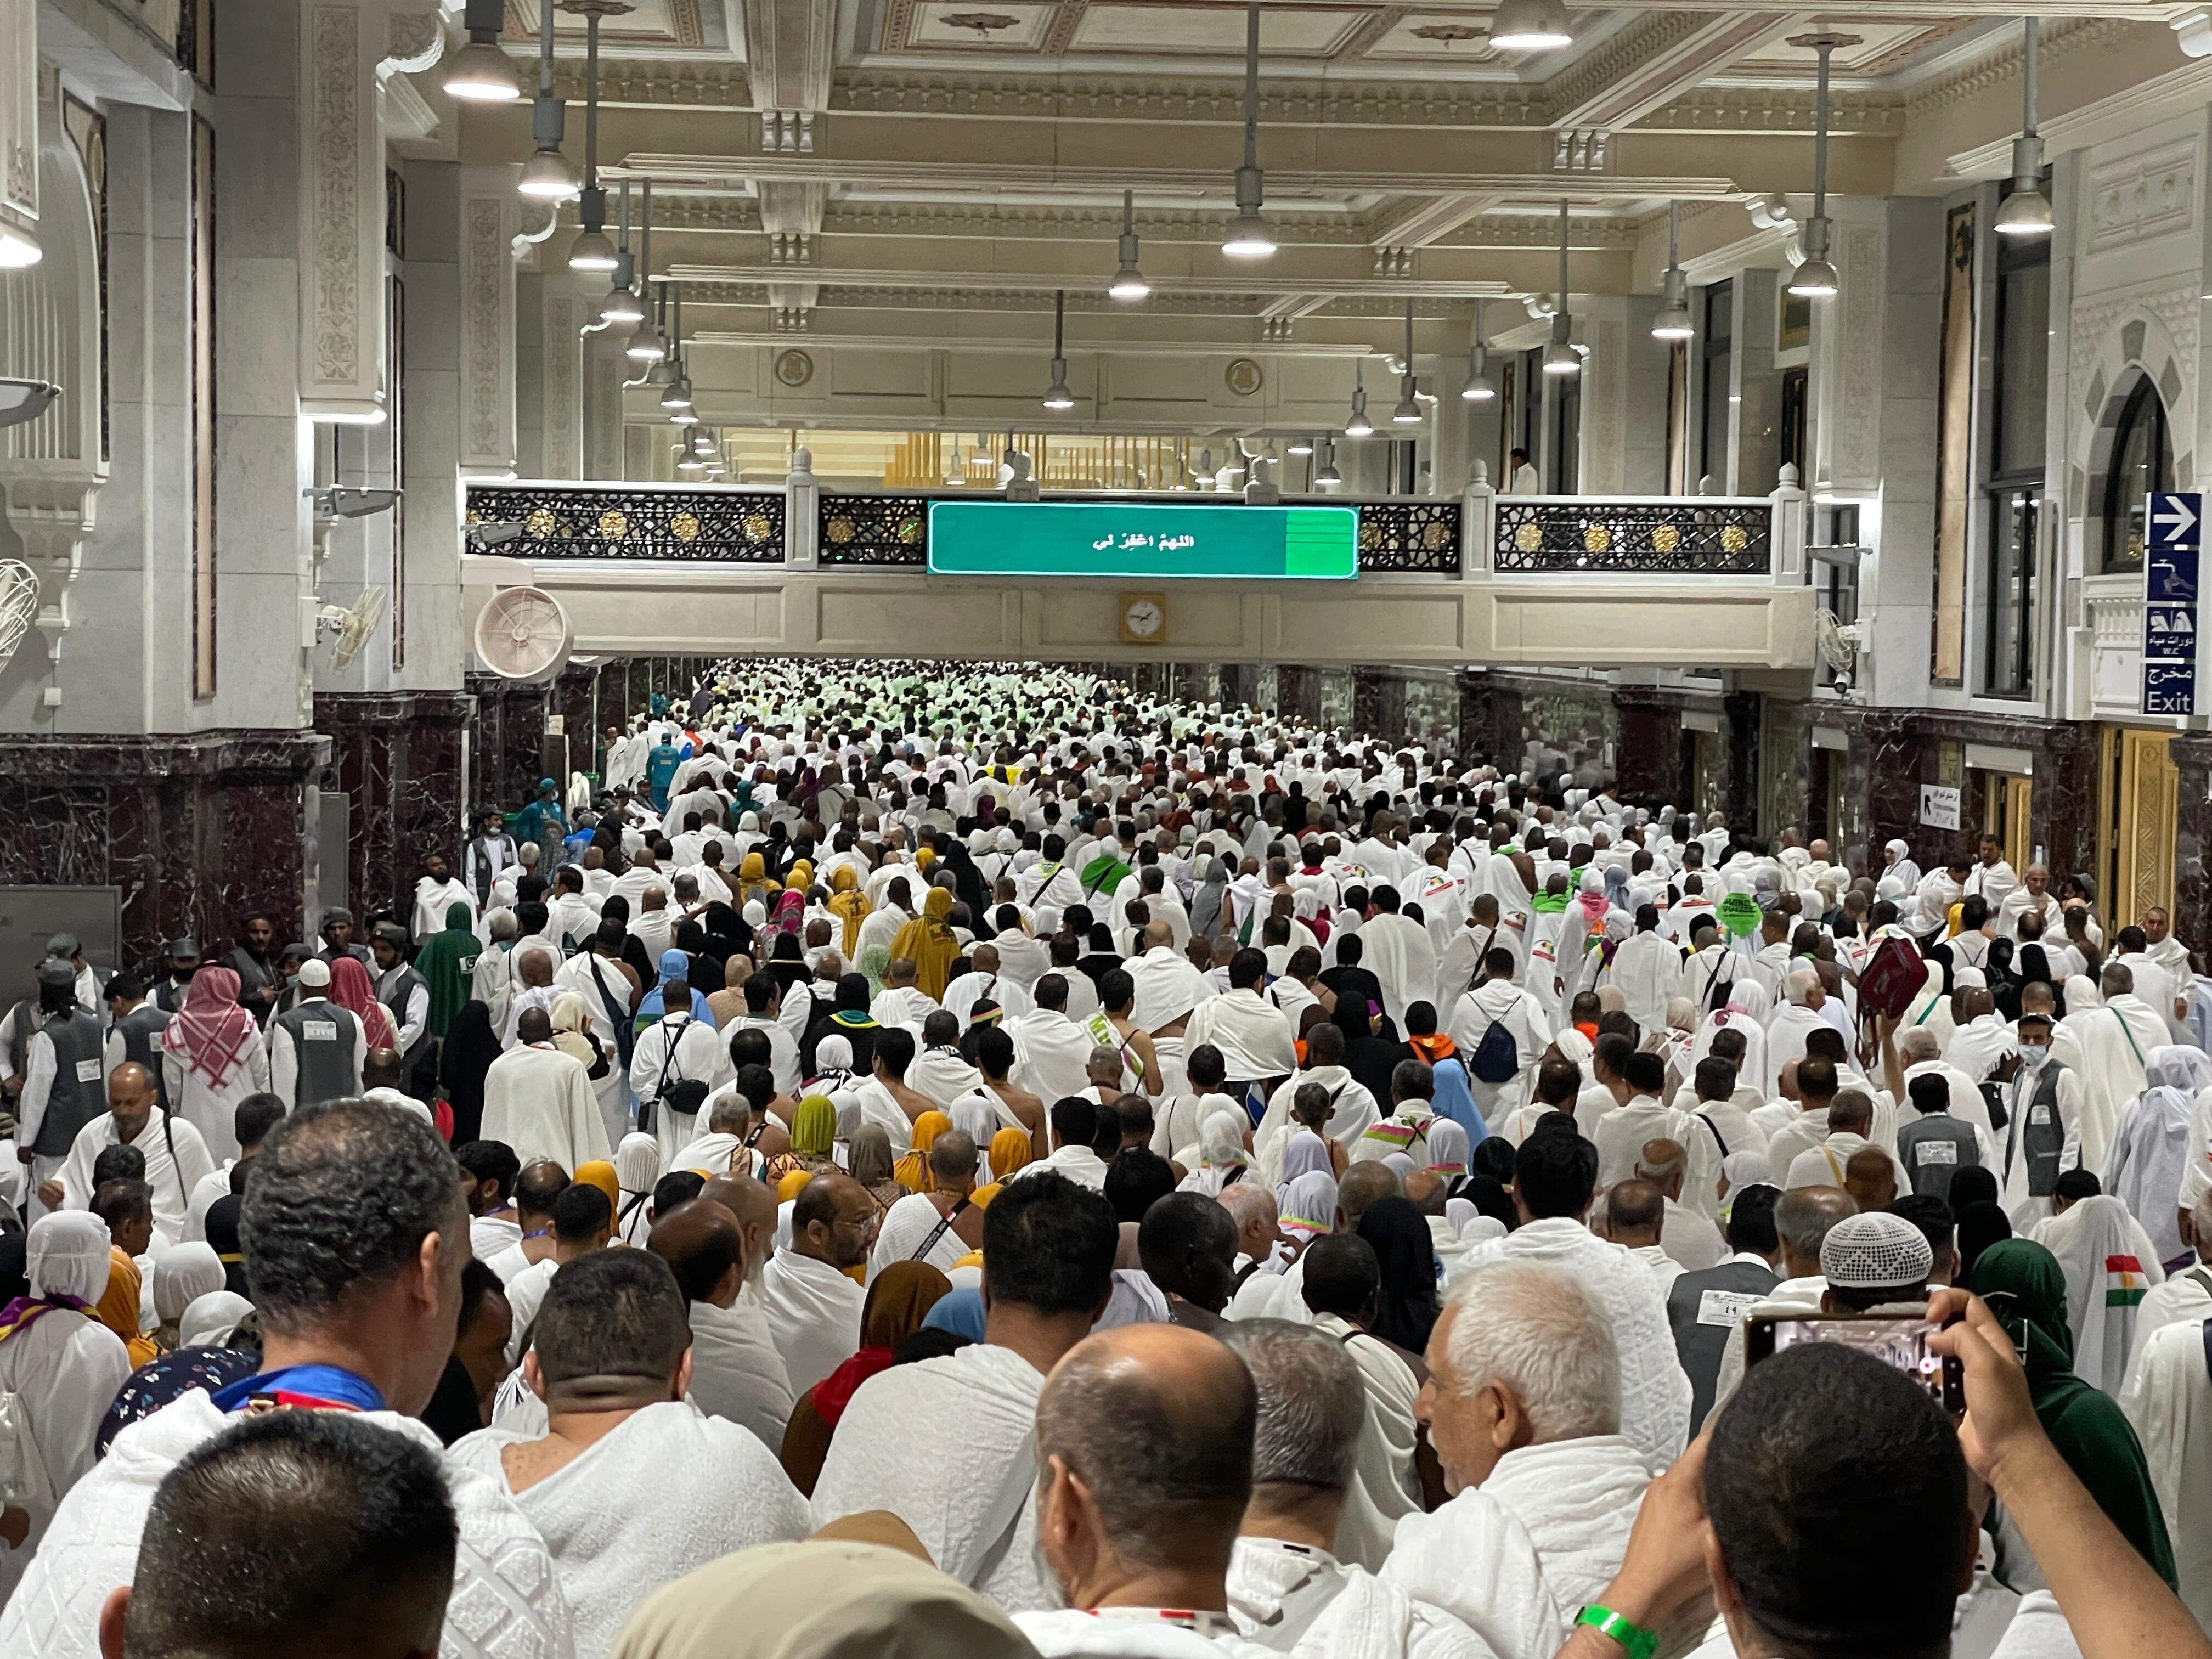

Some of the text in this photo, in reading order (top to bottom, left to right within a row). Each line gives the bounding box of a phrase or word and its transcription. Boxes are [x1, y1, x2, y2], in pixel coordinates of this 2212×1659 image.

[1092, 533, 1114, 551] لي
[2149, 635, 2194, 646] دورات مياه
[2148, 667, 2193, 685] مخرج
[2147, 691, 2191, 712] Exit
